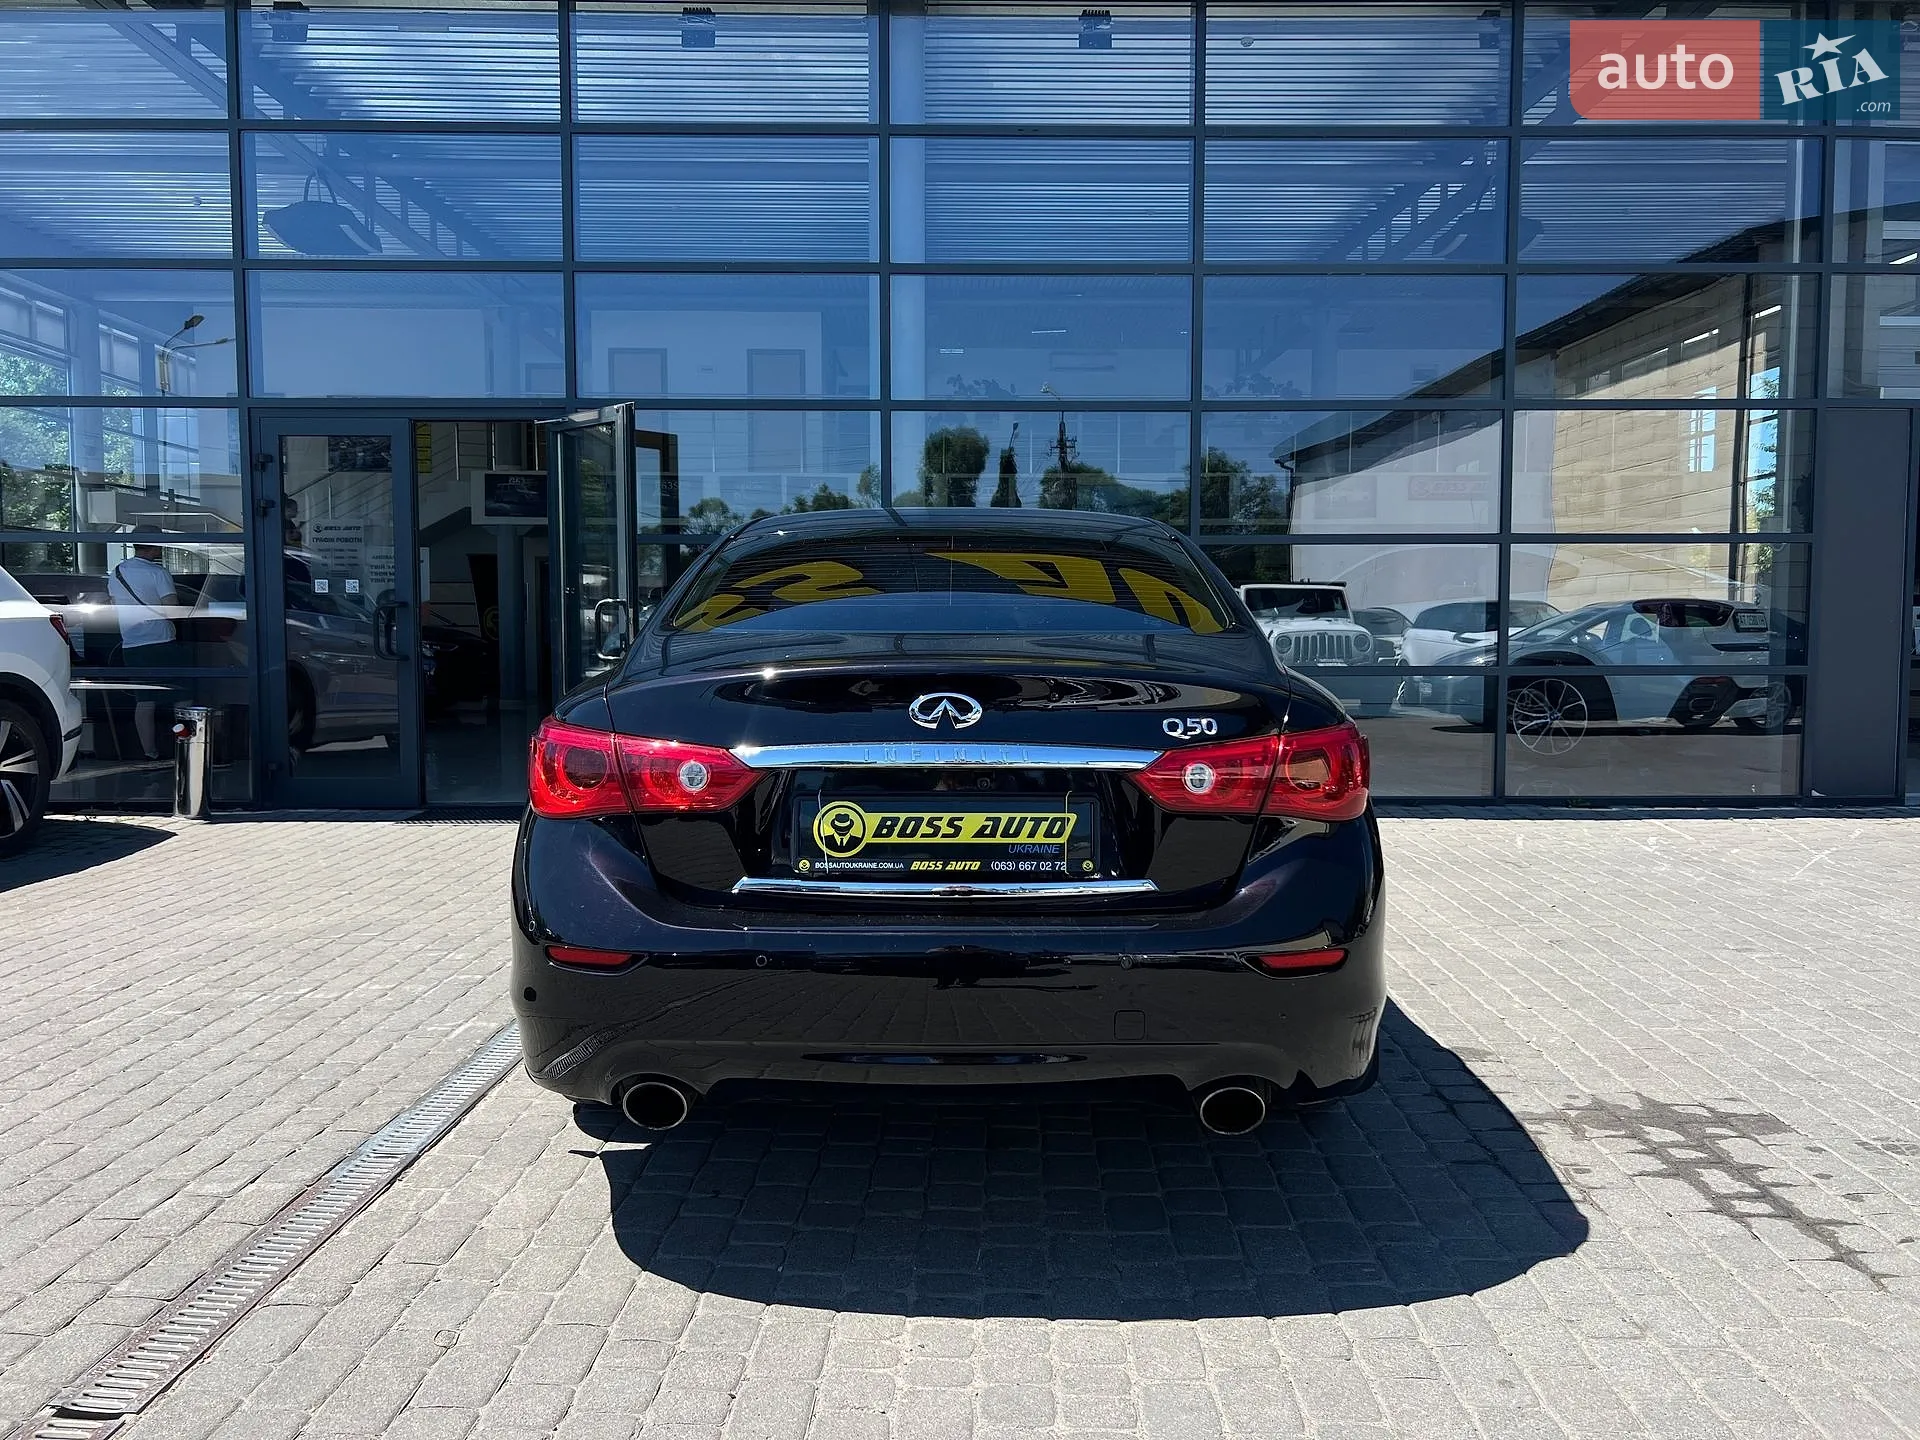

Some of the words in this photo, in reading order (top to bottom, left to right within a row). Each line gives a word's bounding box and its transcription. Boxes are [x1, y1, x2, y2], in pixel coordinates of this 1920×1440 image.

[1162, 717, 1218, 740] Q50
[863, 748, 1029, 762] INFINITI
[872, 816, 965, 839] BOSS
[970, 816, 1072, 839] AUTO
[1008, 844, 1060, 854] UKRAINE
[910, 861, 943, 870] BOSS
[945, 861, 981, 870] AUTO
[990, 861, 1016, 871] (063)
[1018, 861, 1037, 871] 667
[1040, 861, 1052, 871] 02
